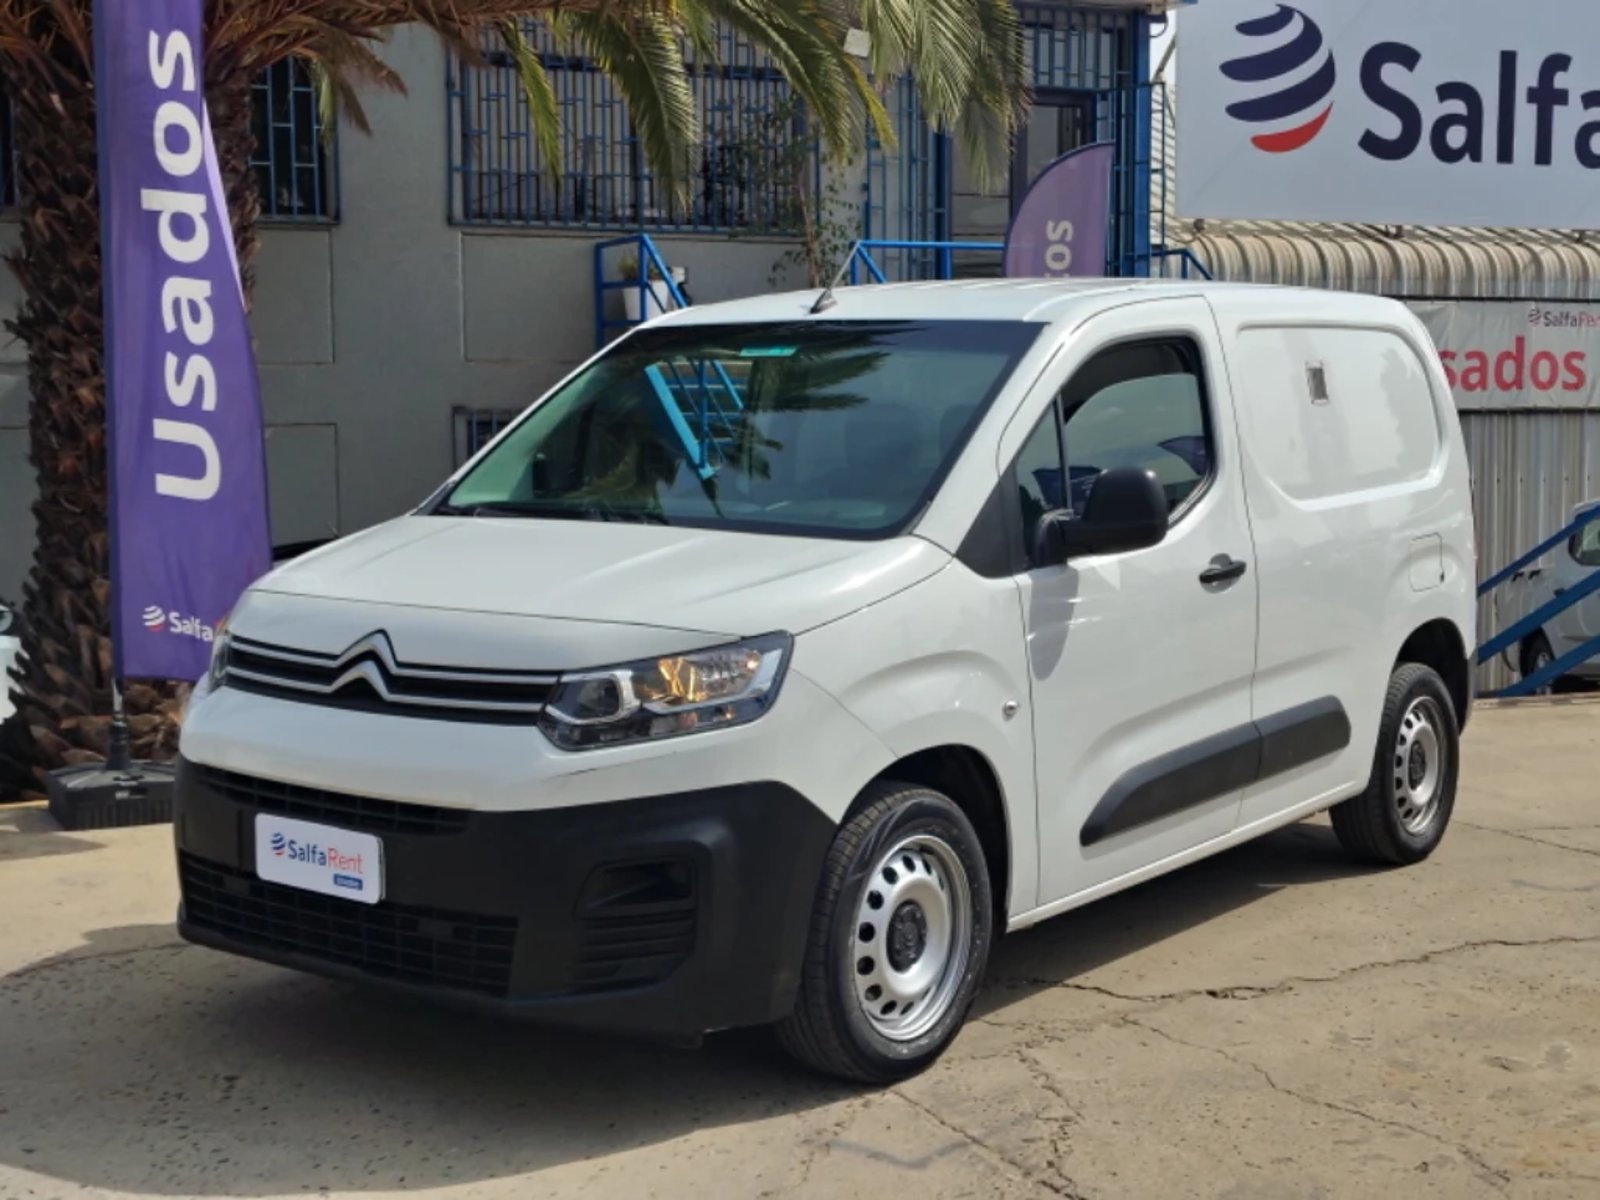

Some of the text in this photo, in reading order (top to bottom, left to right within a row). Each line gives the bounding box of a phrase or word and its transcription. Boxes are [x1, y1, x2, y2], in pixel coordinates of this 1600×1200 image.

[140, 30, 222, 502] Usados
[1044, 219, 1073, 278] os
[168, 611, 219, 642] Salfa
[288, 839, 363, 875] SalfaRent
